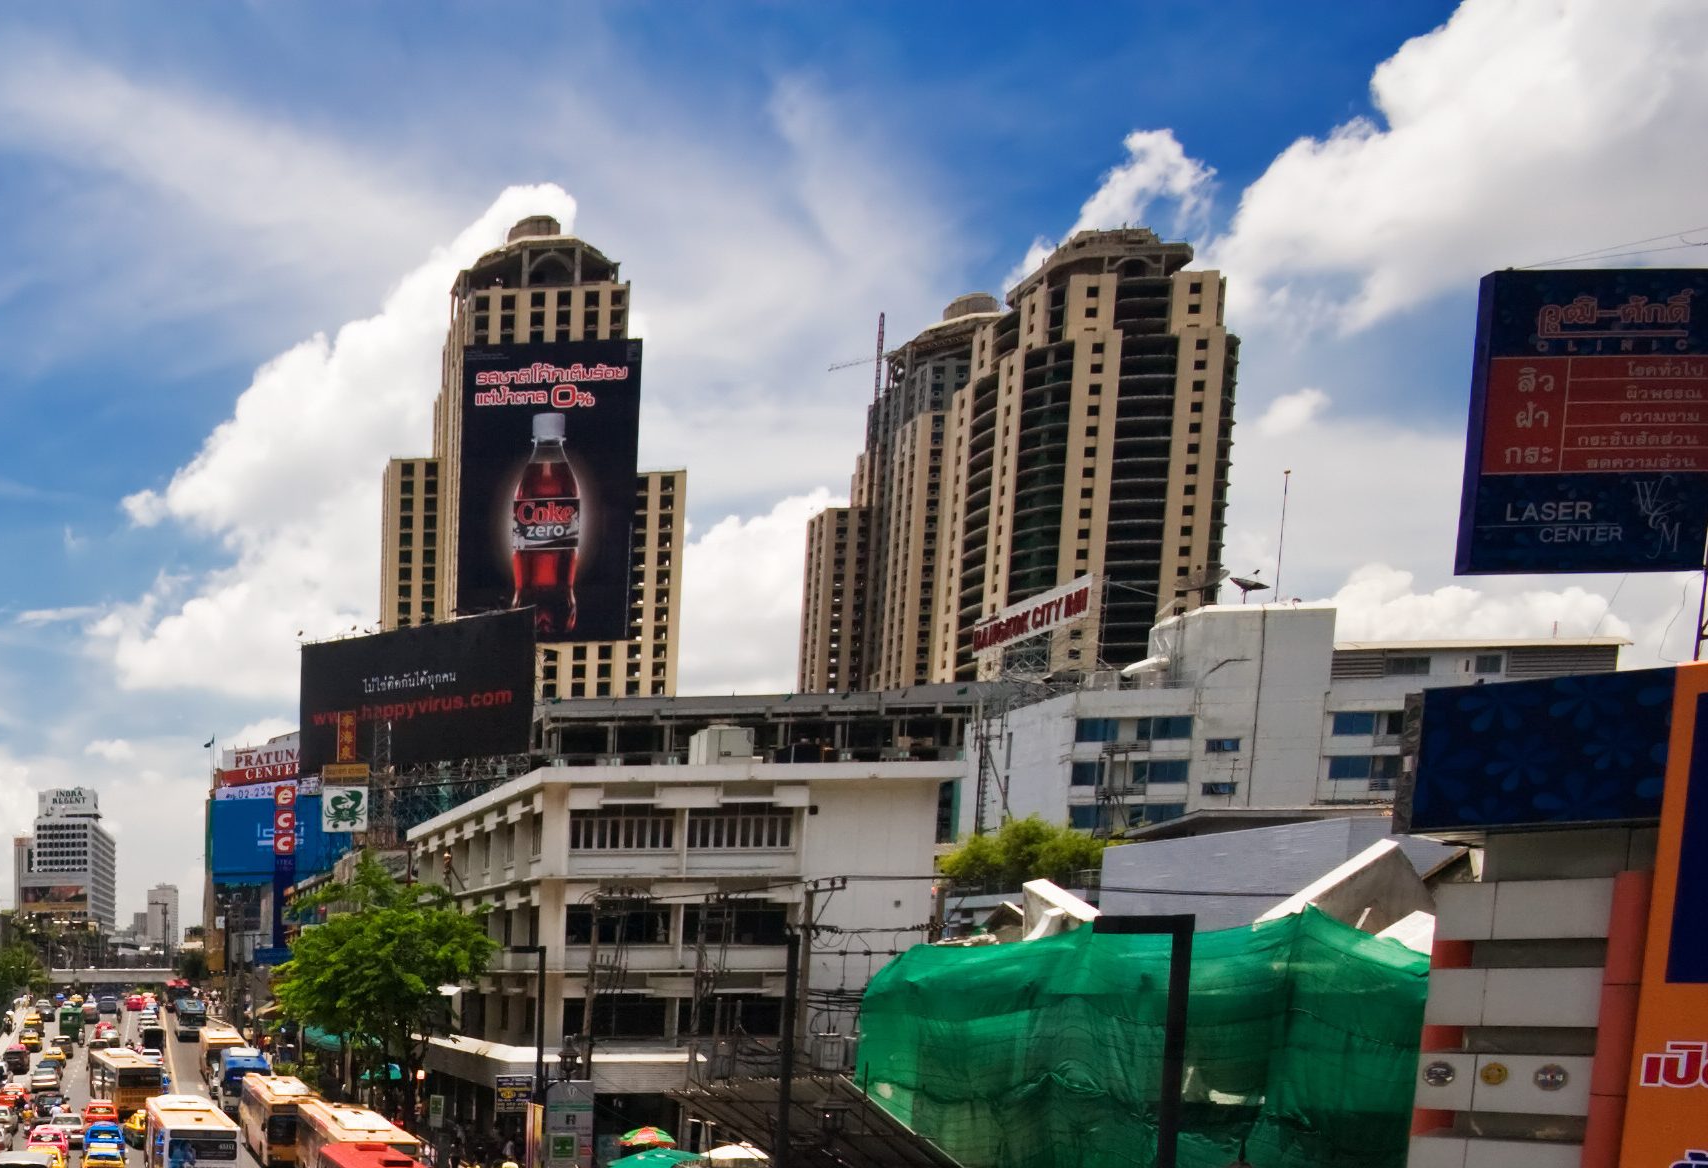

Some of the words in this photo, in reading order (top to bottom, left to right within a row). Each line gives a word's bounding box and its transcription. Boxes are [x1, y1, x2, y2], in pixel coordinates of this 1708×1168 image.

[1537, 339, 1689, 352] CLINIC
[1517, 367, 1555, 392] สิว
[551, 384, 596, 409] 0%
[1516, 401, 1550, 428] ฝ้า
[1504, 447, 1554, 465] กระ
[516, 501, 574, 525] Coke
[1505, 501, 1594, 522] LASER
[525, 524, 565, 537] zero
[1538, 526, 1623, 543] CENTER
[1032, 597, 1063, 629] CITY
